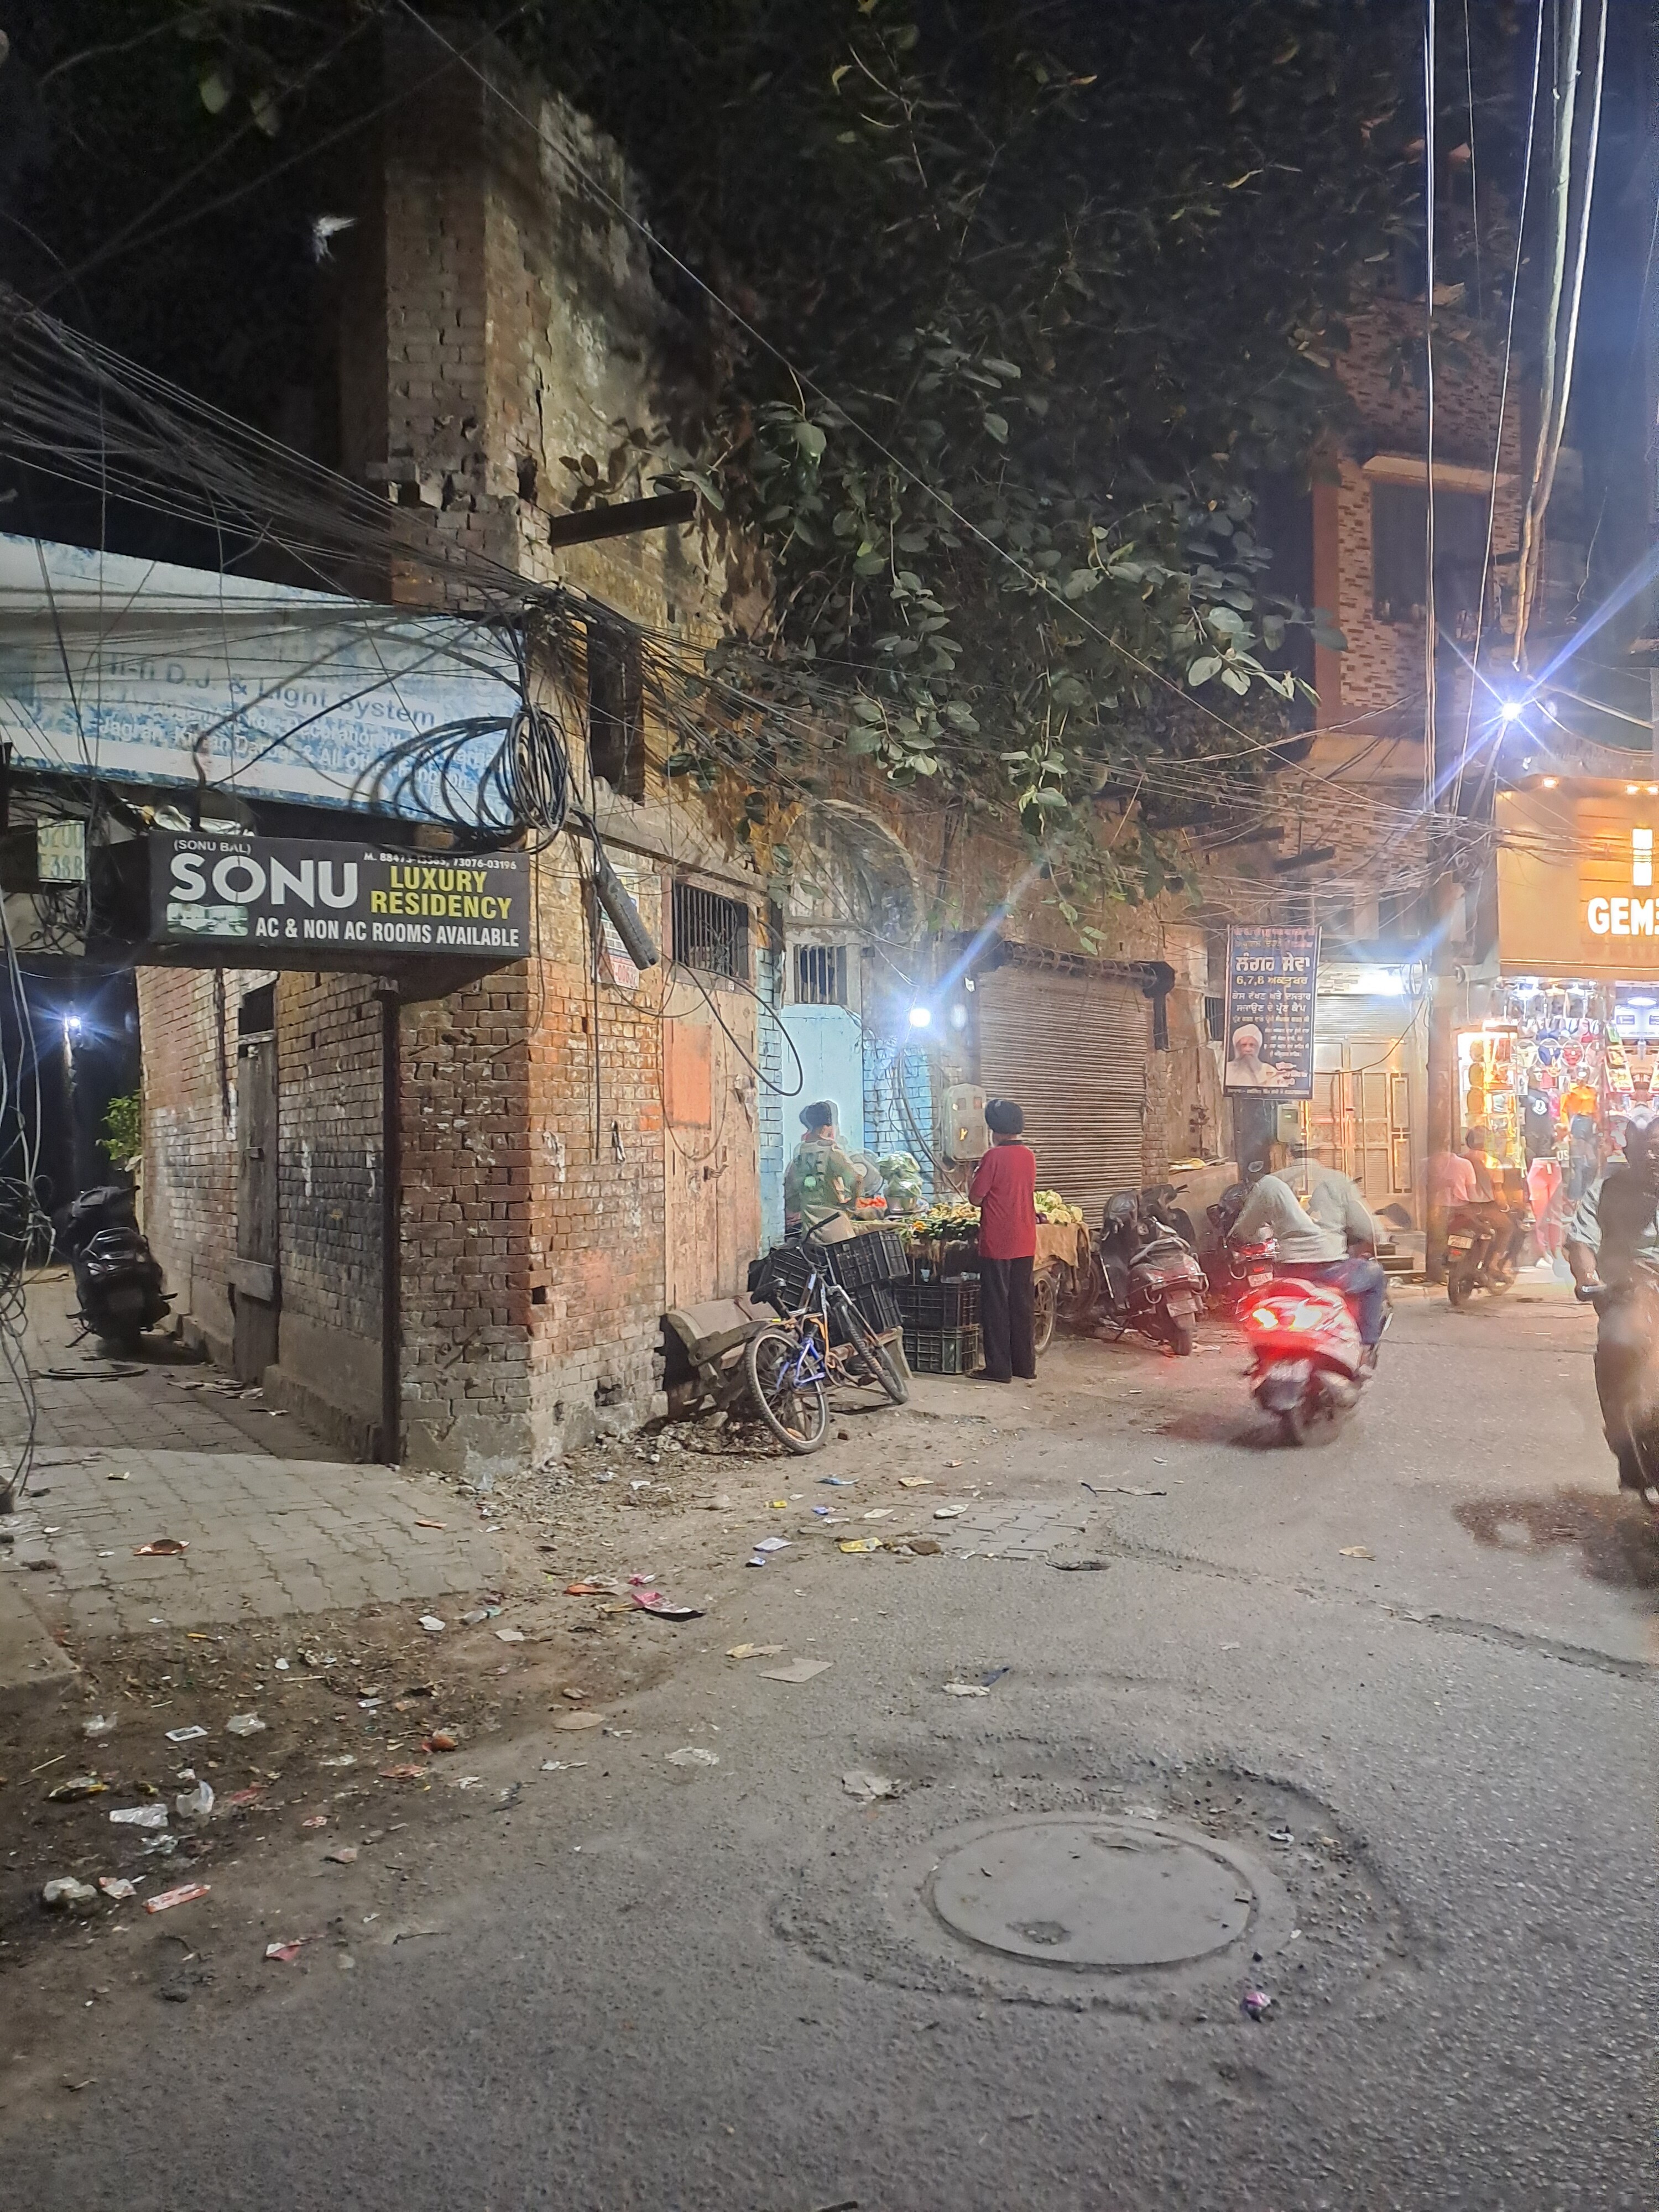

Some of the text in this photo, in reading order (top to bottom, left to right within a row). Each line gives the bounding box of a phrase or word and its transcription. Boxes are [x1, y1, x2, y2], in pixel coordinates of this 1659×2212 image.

[339, 691, 435, 727] System
[174, 839, 252, 855] (SONU BAL)
[390, 865, 488, 893] LUXURY
[453, 858, 517, 870] 73076-03196
[168, 852, 358, 908] SONU
[371, 890, 512, 920] RESIDENCY
[1587, 896, 1659, 936] GEM
[255, 917, 520, 947] AC & NON AC ROOMS AVAILABLE
